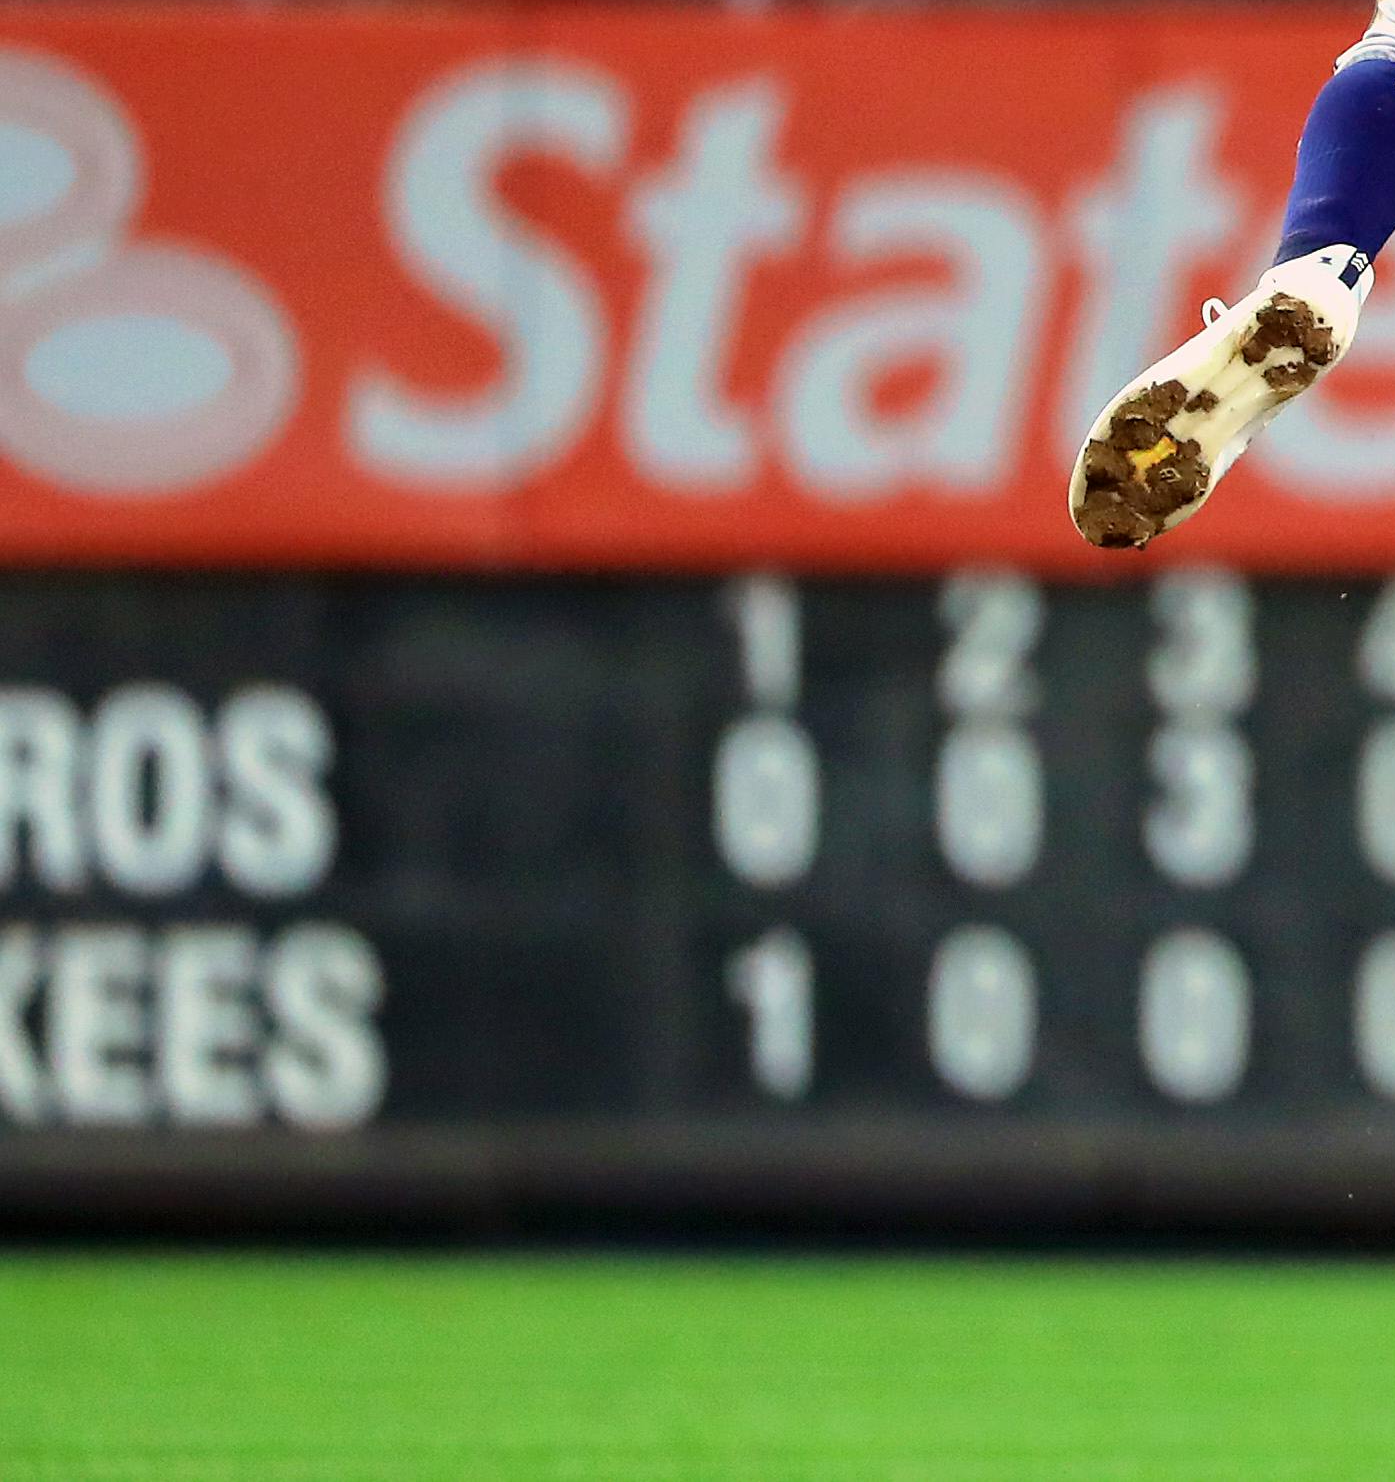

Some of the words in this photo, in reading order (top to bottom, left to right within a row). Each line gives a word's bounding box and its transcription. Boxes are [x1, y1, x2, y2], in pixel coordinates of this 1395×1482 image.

[738, 573, 800, 704] 1
[940, 573, 1038, 718] 2
[1147, 718, 1253, 885] 3
[730, 928, 812, 1096] 1
